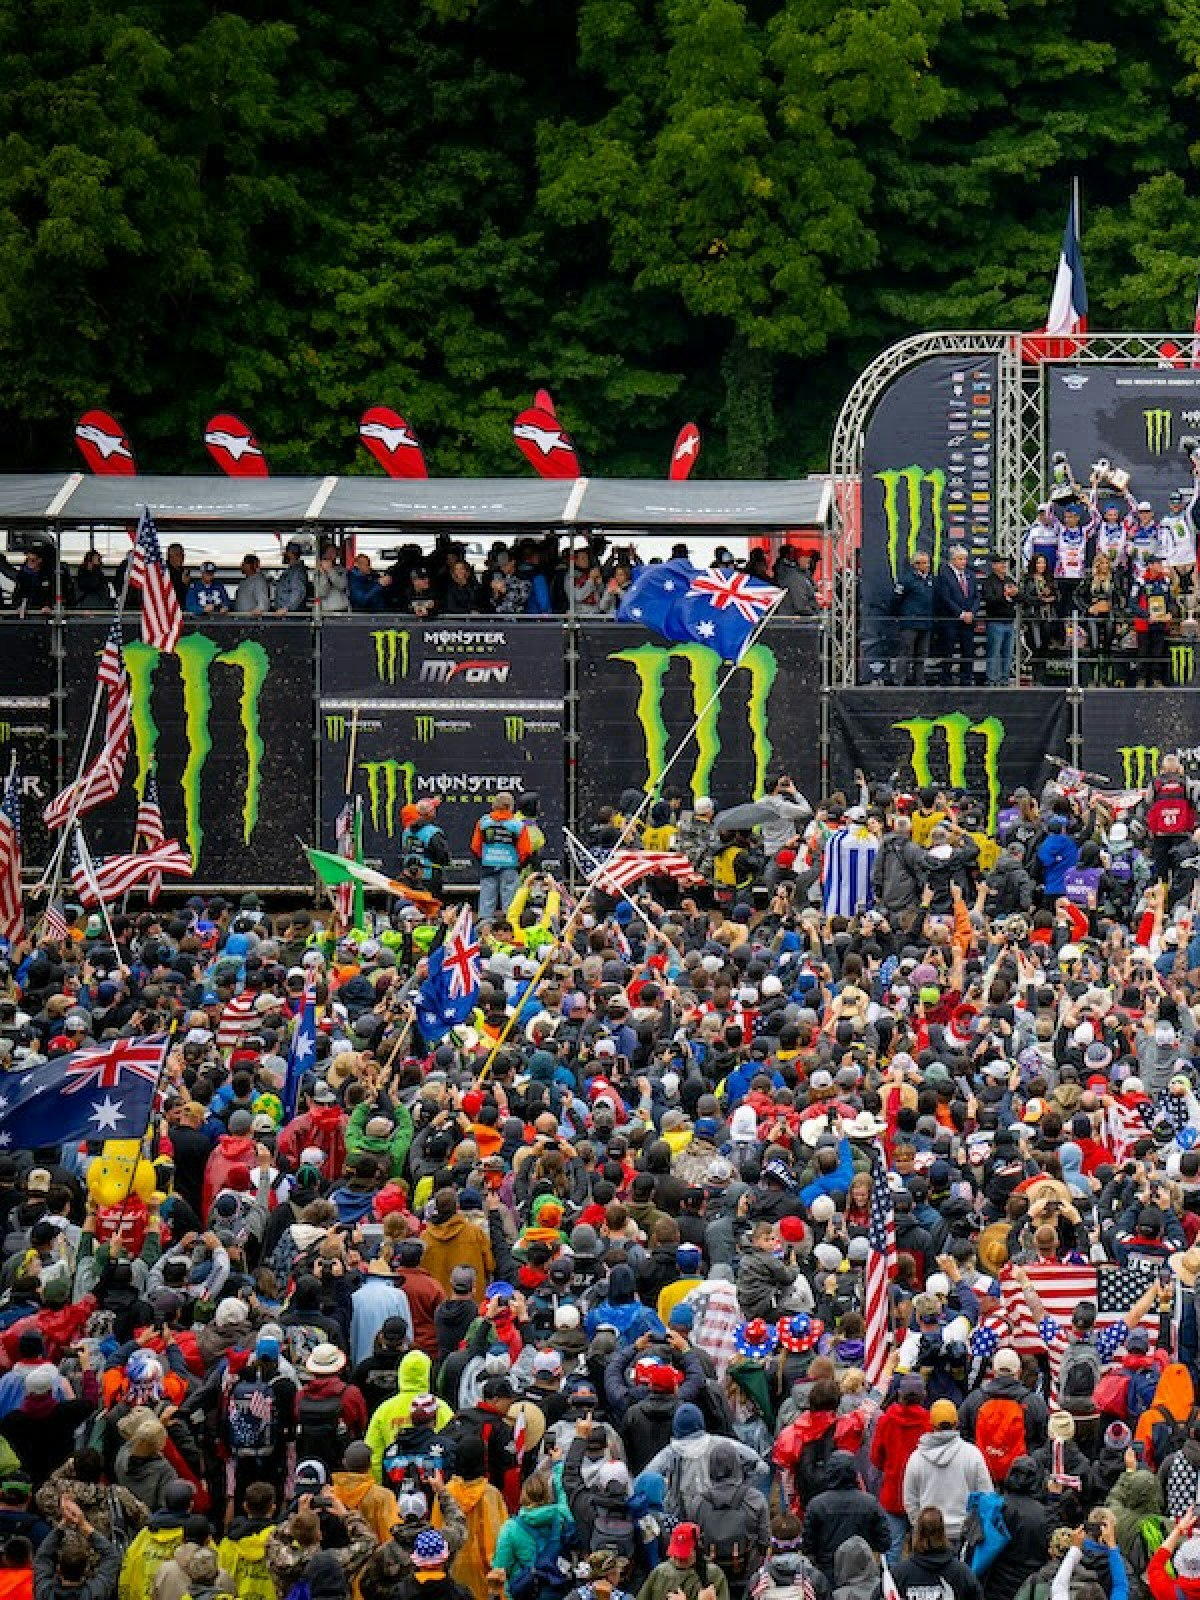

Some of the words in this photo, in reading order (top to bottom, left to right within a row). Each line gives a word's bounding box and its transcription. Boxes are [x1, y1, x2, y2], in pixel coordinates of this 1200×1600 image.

[423, 629, 507, 645] MONSTER
[435, 645, 497, 653] ENERGY
[416, 772, 526, 793] MONSTER
